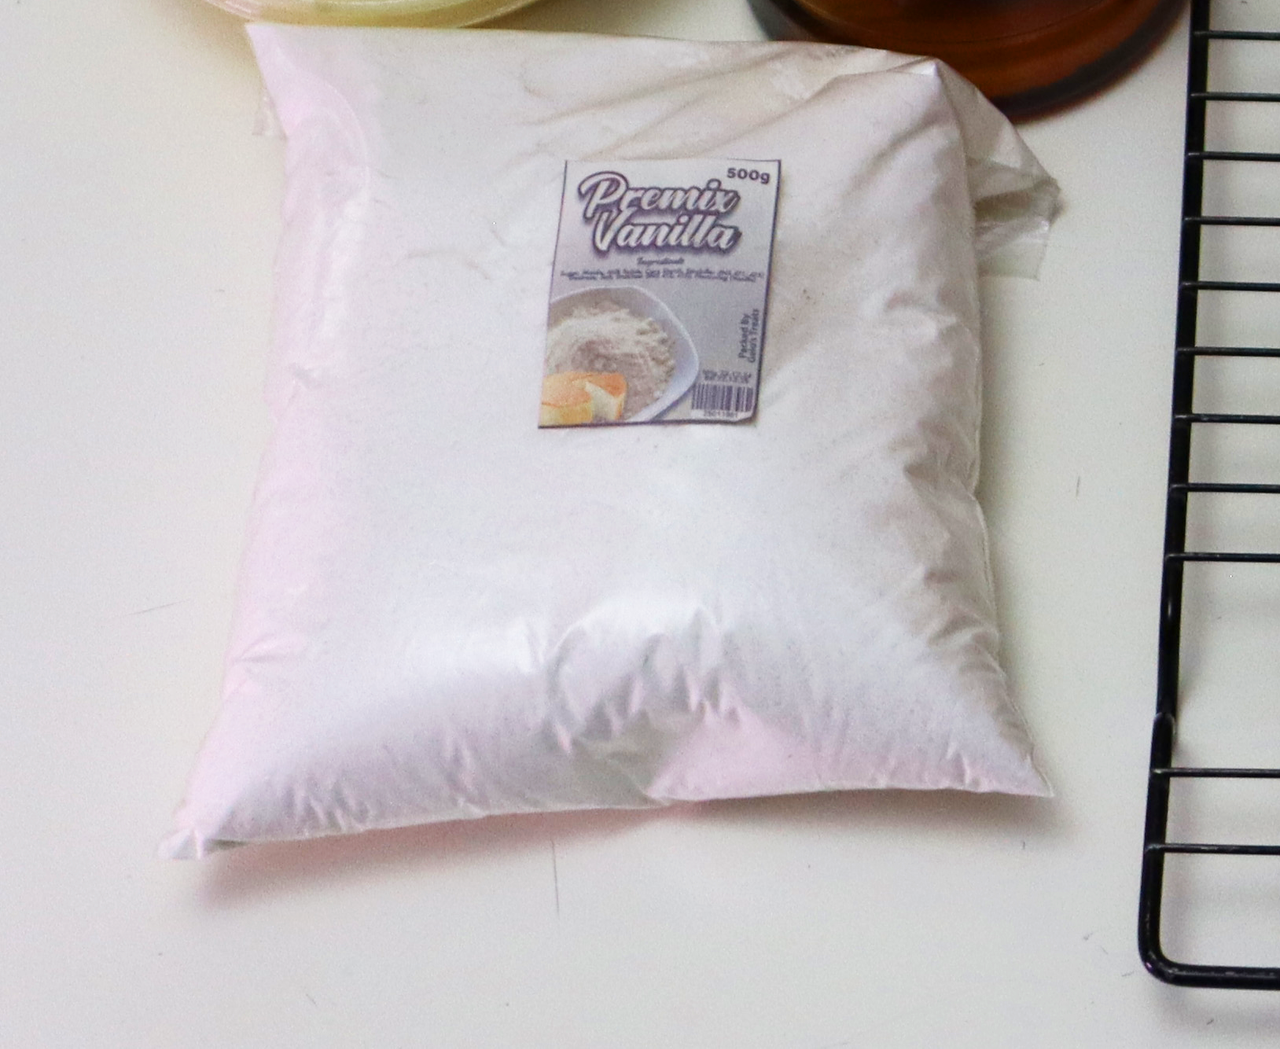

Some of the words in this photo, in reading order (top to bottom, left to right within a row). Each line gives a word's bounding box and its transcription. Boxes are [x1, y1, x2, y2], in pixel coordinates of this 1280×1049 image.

[577, 170, 741, 220] Premix
[726, 167, 770, 185] 500g
[592, 203, 742, 254] Vanilla
